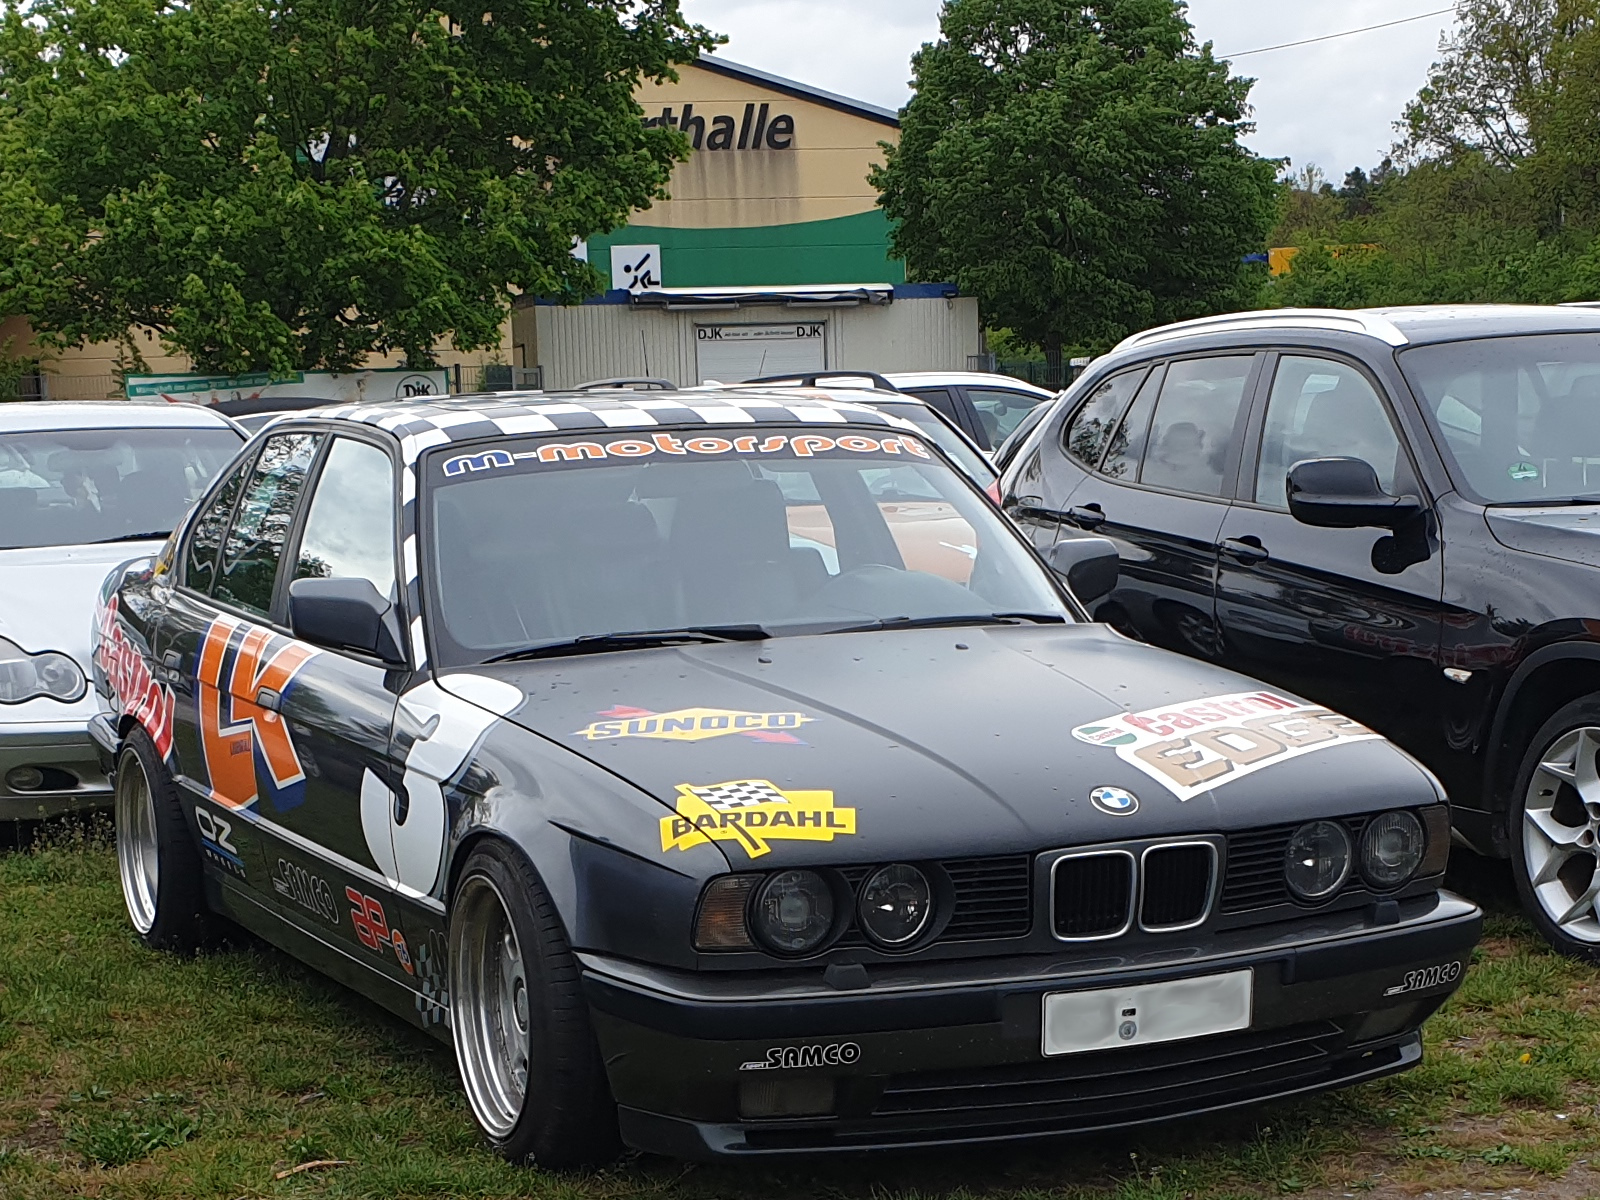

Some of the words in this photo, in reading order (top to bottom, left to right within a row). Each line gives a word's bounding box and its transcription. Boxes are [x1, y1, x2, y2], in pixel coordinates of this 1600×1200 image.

[698, 328, 722, 339] DJK
[796, 326, 821, 338] DJK
[443, 434, 930, 477] m-motorsport
[593, 713, 795, 738] SUNOCO
[1122, 692, 1300, 736] Castrol
[1134, 709, 1376, 788] EDGE
[195, 806, 238, 855] OZ
[672, 810, 846, 840] BARDAHL
[274, 858, 339, 924] SAMCO
[1402, 961, 1460, 991] SAMCO
[766, 1042, 860, 1069] SAMCO
